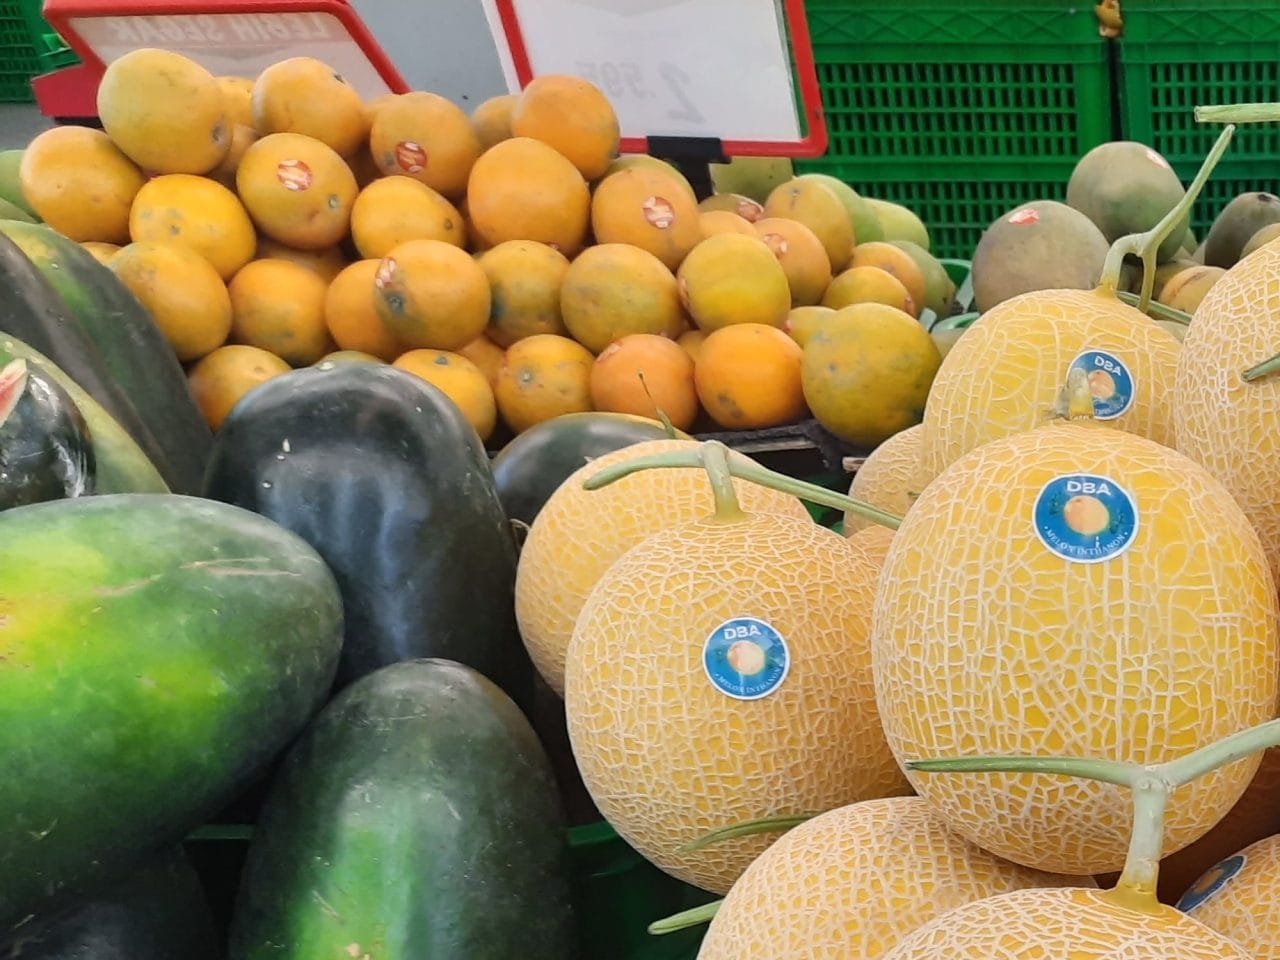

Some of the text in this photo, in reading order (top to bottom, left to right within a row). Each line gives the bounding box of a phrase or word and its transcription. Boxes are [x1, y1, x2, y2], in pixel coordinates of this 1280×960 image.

[1094, 355, 1121, 377] DBA
[1066, 480, 1112, 496] DBA
[1047, 529, 1076, 553] MELON
[724, 624, 762, 640] DBA
